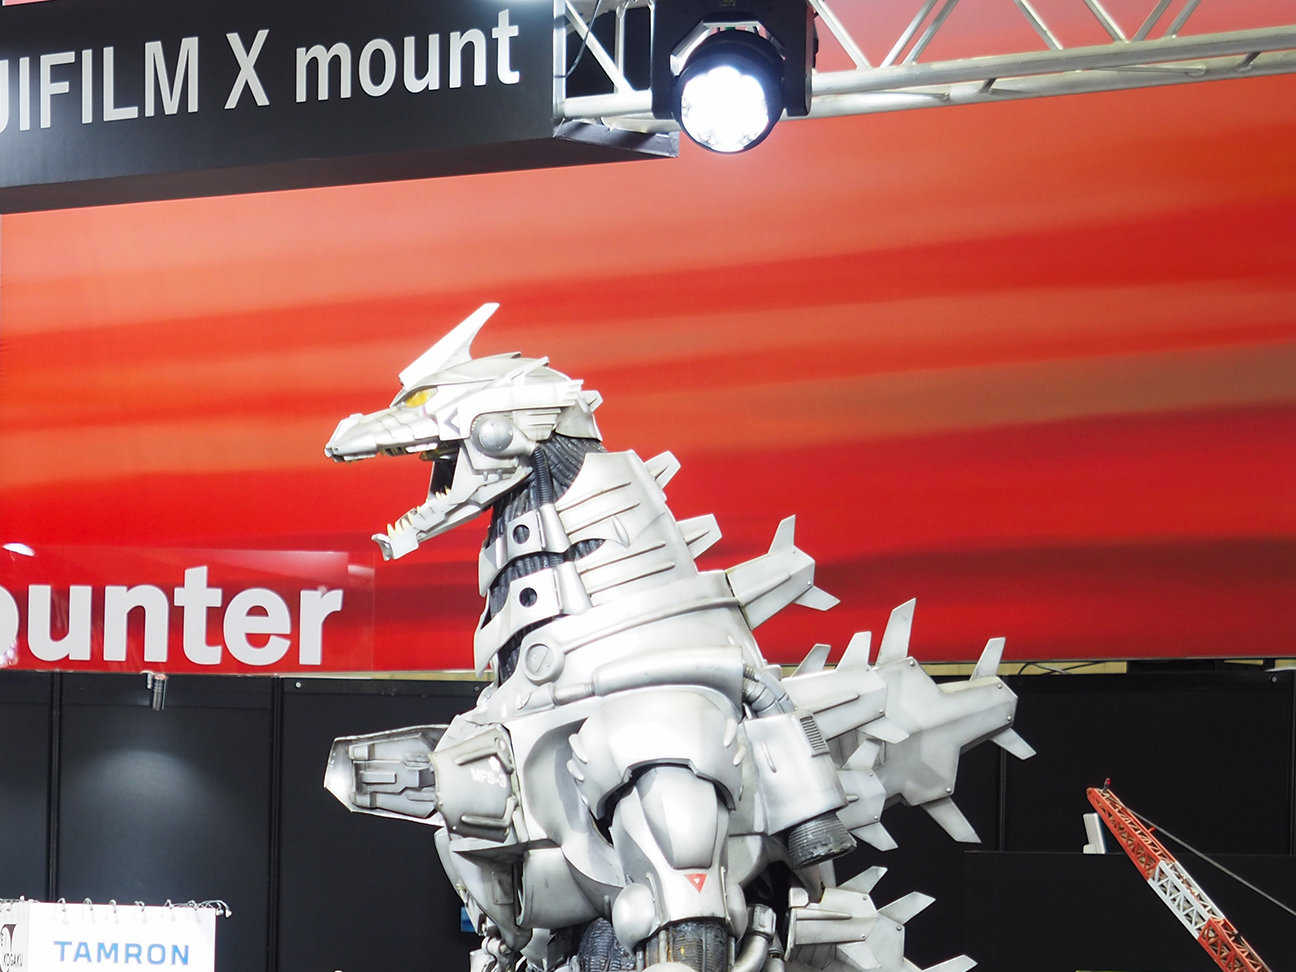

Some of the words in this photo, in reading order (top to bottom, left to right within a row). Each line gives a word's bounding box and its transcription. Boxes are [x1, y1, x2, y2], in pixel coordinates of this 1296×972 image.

[224, 29, 270, 110] X
[295, 9, 520, 103] mount
[53, 940, 190, 966] TAMRON
